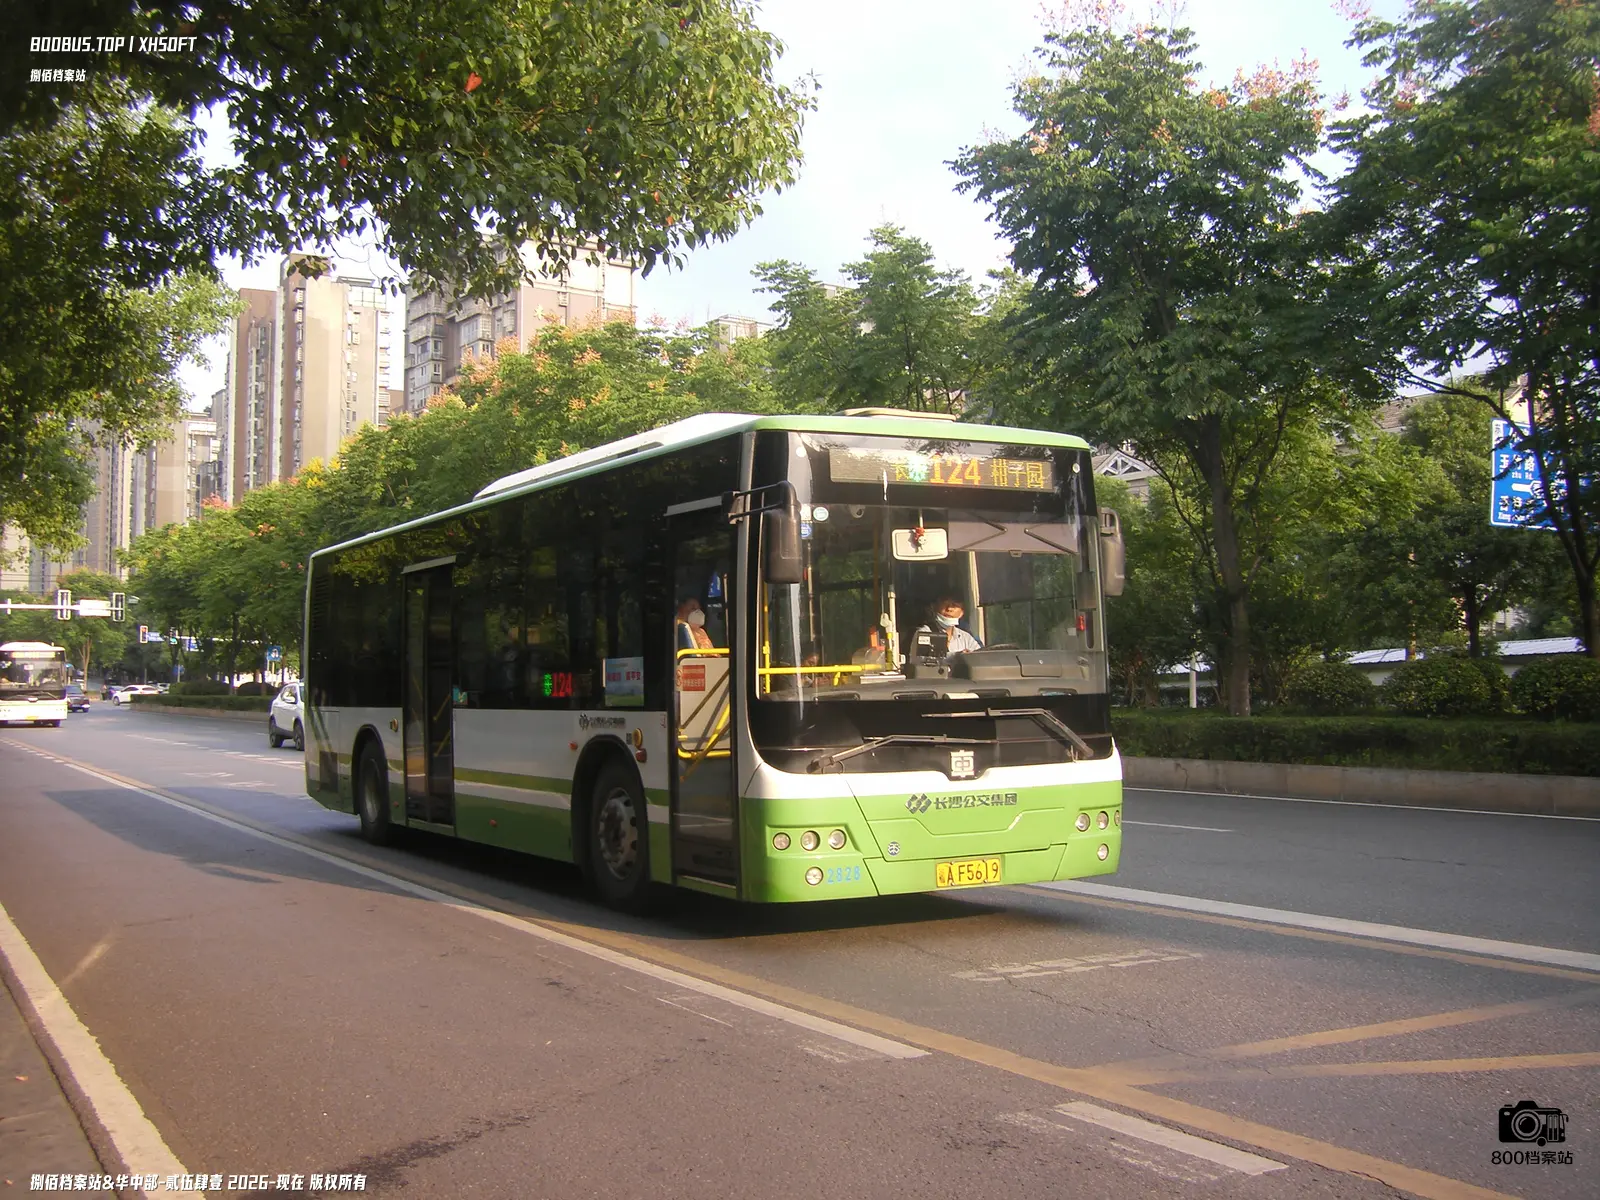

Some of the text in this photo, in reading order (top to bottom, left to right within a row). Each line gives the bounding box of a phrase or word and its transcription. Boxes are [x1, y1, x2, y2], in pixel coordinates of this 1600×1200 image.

[930, 454, 982, 486] 124
[991, 458, 1045, 488] 柑子园
[552, 672, 573, 697] 124
[934, 793, 1018, 810] 长沙公交集团
[827, 866, 861, 884] 2828
[938, 860, 999, 886] AF5619
